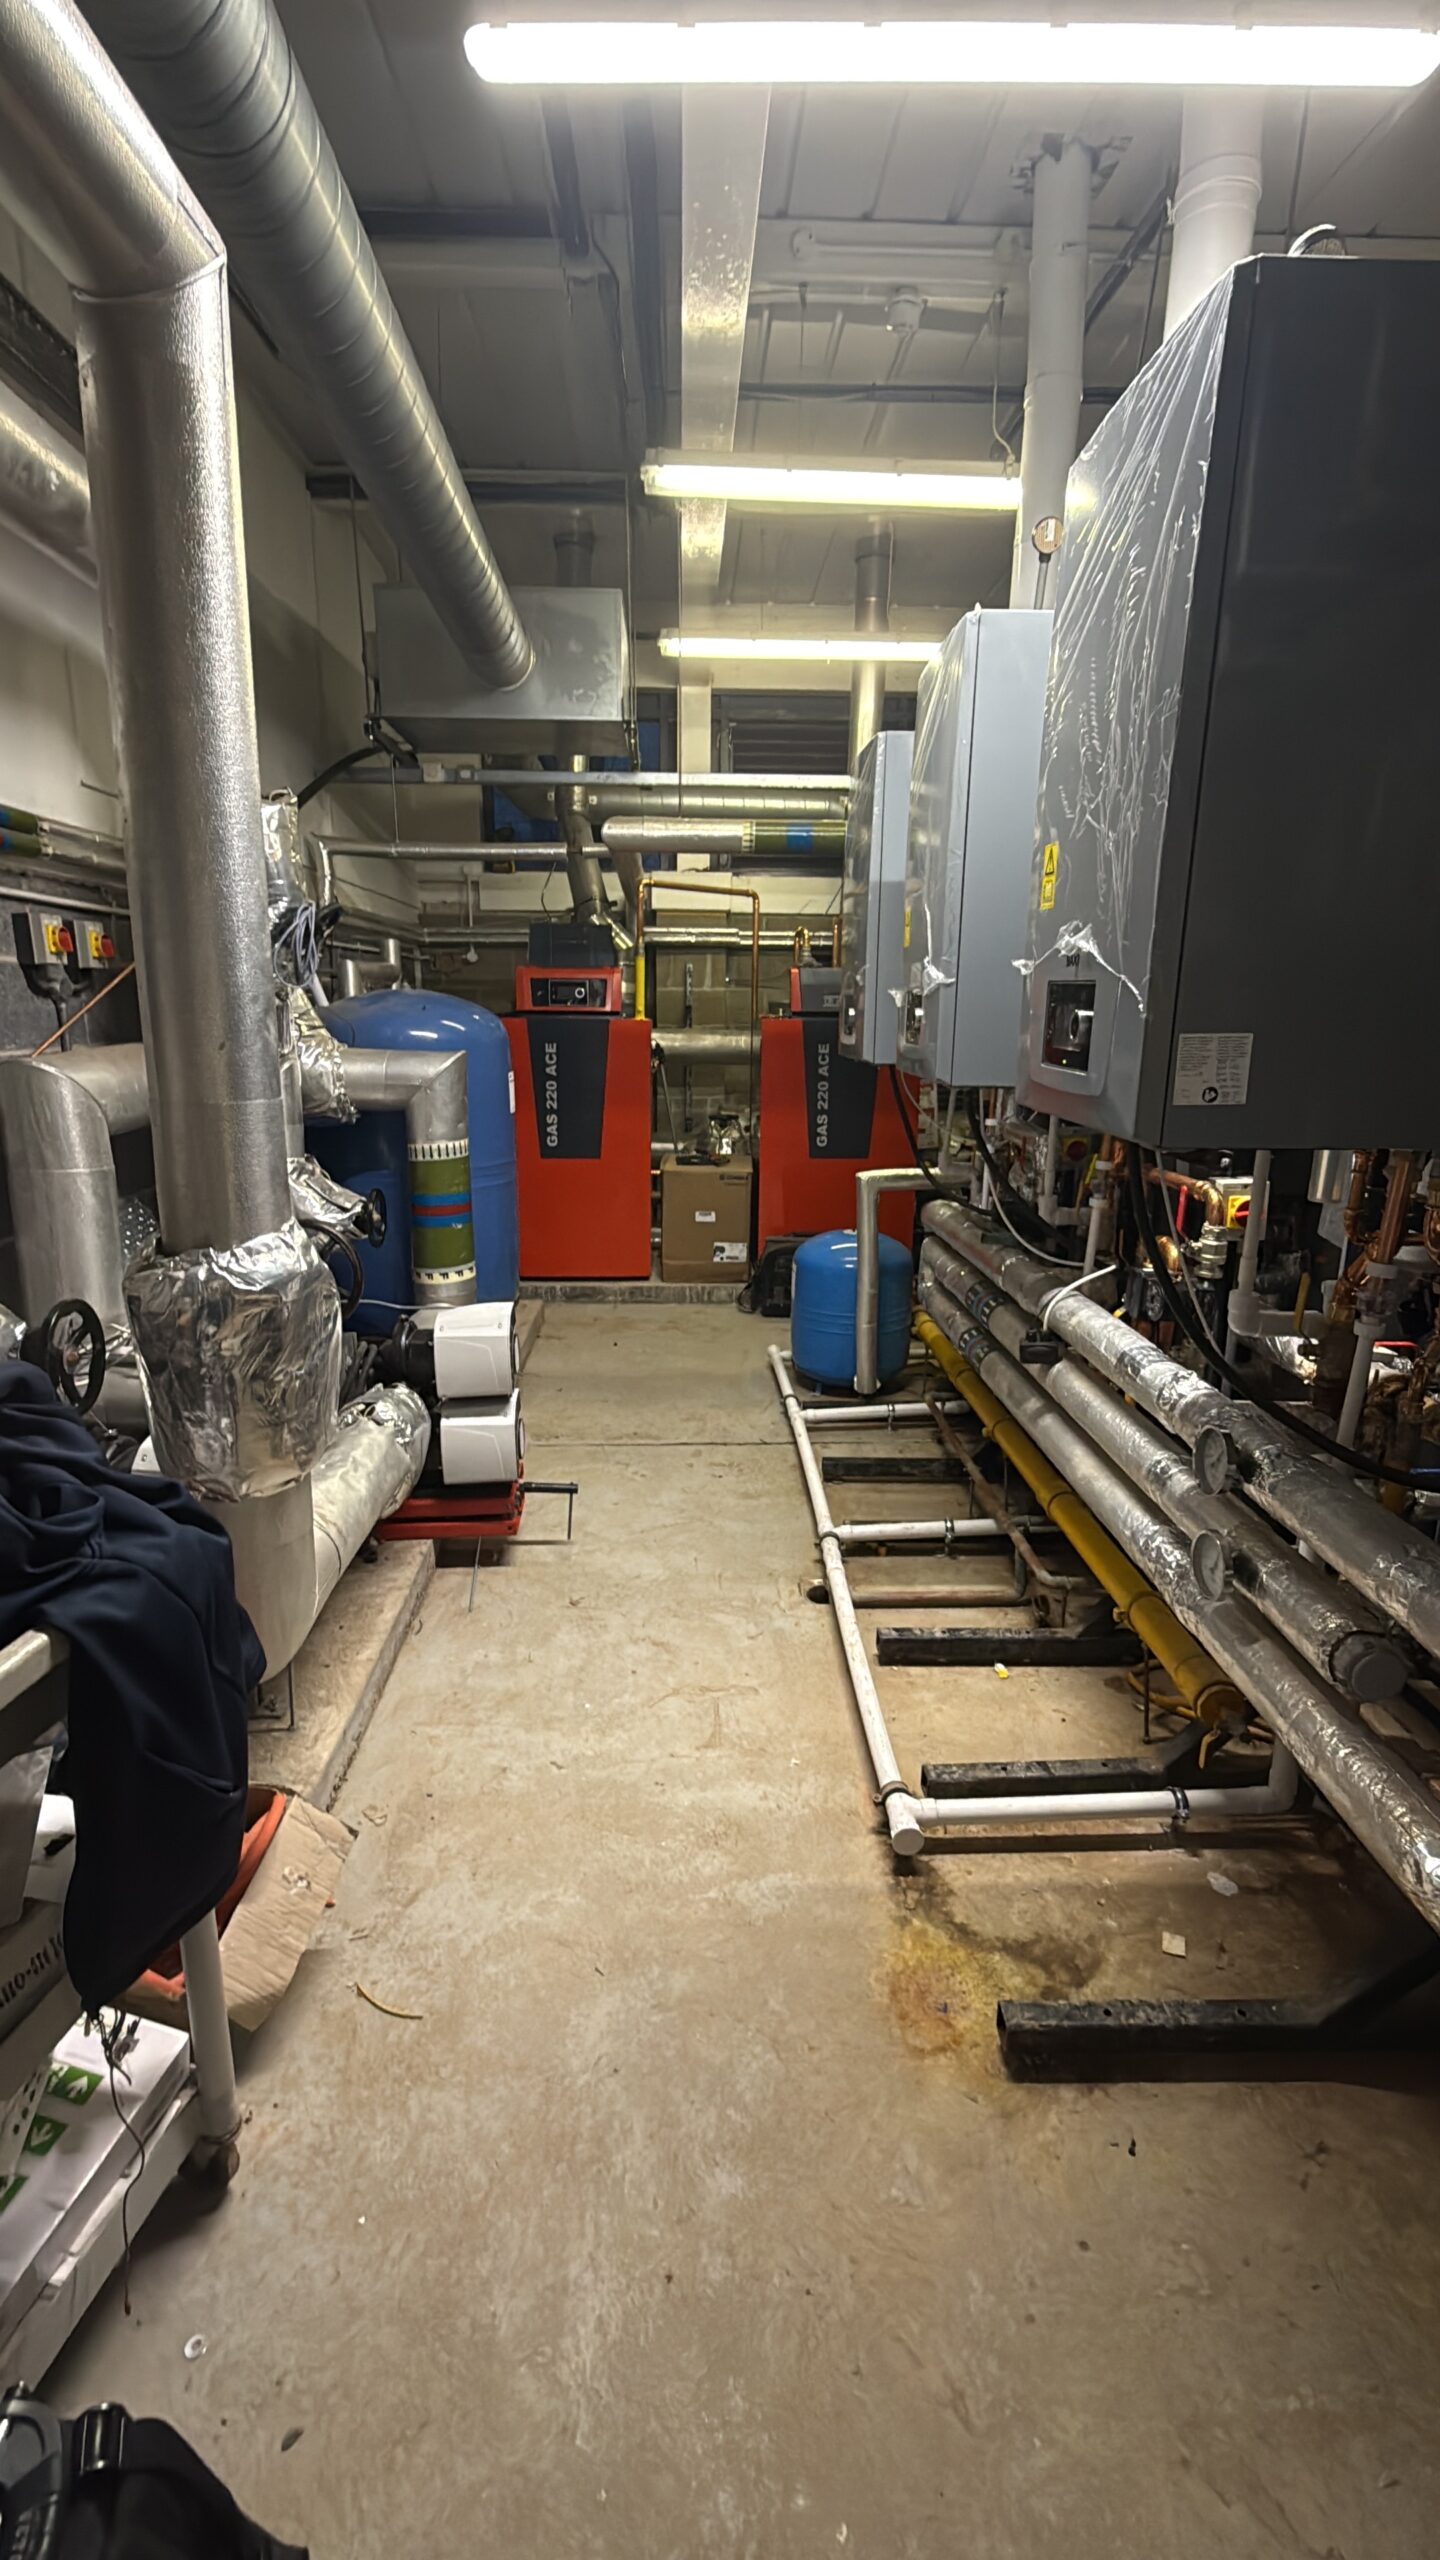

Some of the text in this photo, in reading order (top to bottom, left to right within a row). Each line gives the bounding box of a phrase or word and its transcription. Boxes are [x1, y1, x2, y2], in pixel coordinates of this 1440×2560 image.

[545, 1042, 558, 1147] GAS 220 ACE
[816, 1043, 830, 1148] GAS 220 ACE
